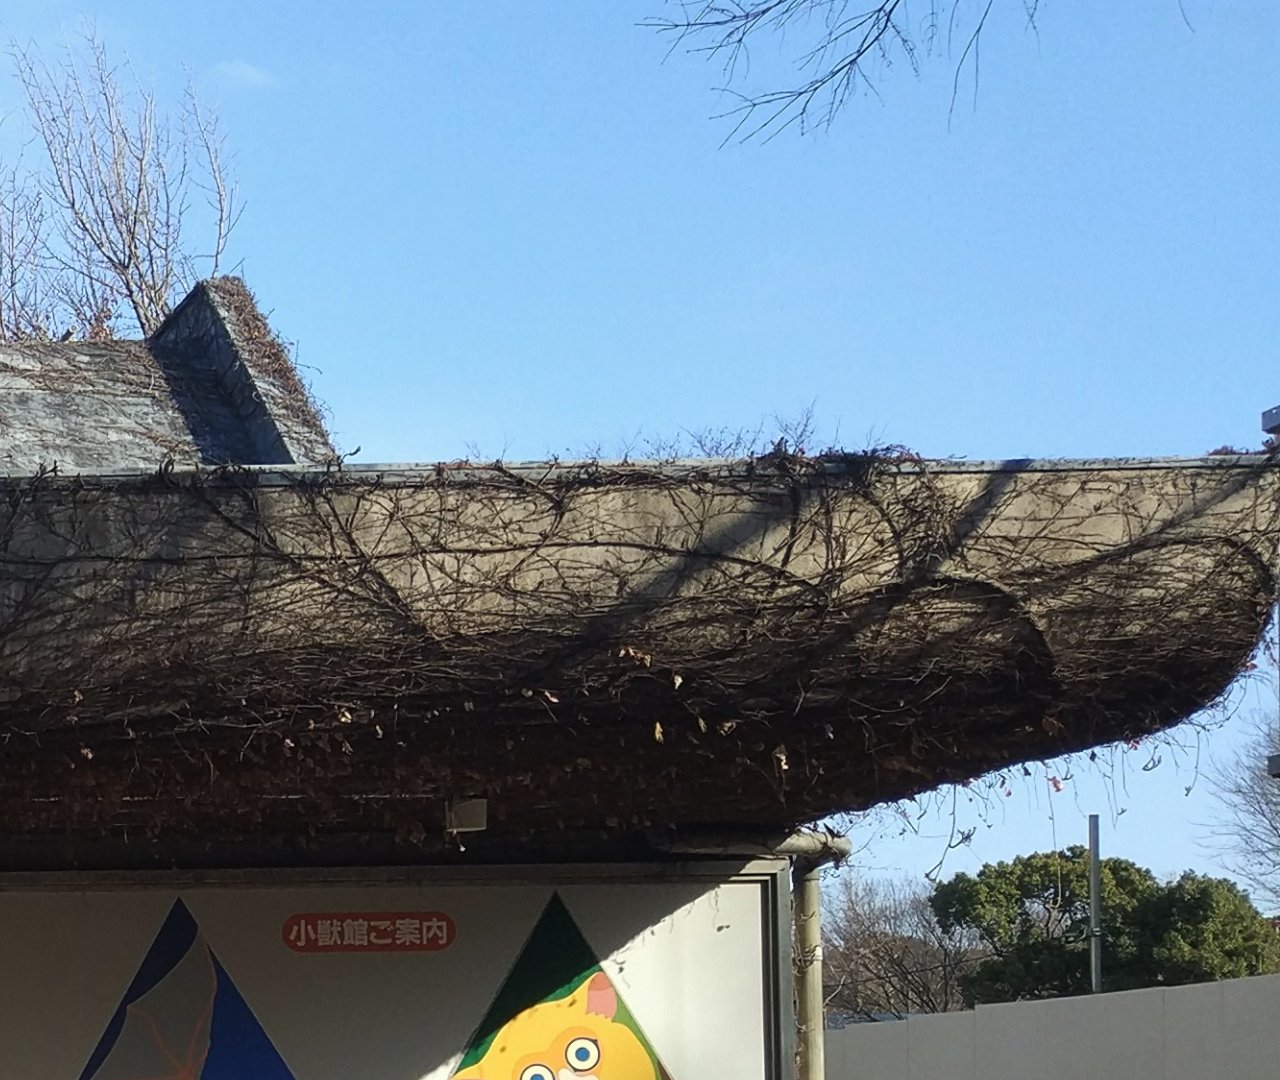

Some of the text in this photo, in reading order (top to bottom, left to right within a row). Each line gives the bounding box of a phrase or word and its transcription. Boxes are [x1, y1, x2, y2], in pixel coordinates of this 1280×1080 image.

[289, 918, 448, 947] 小獣館ご案内
